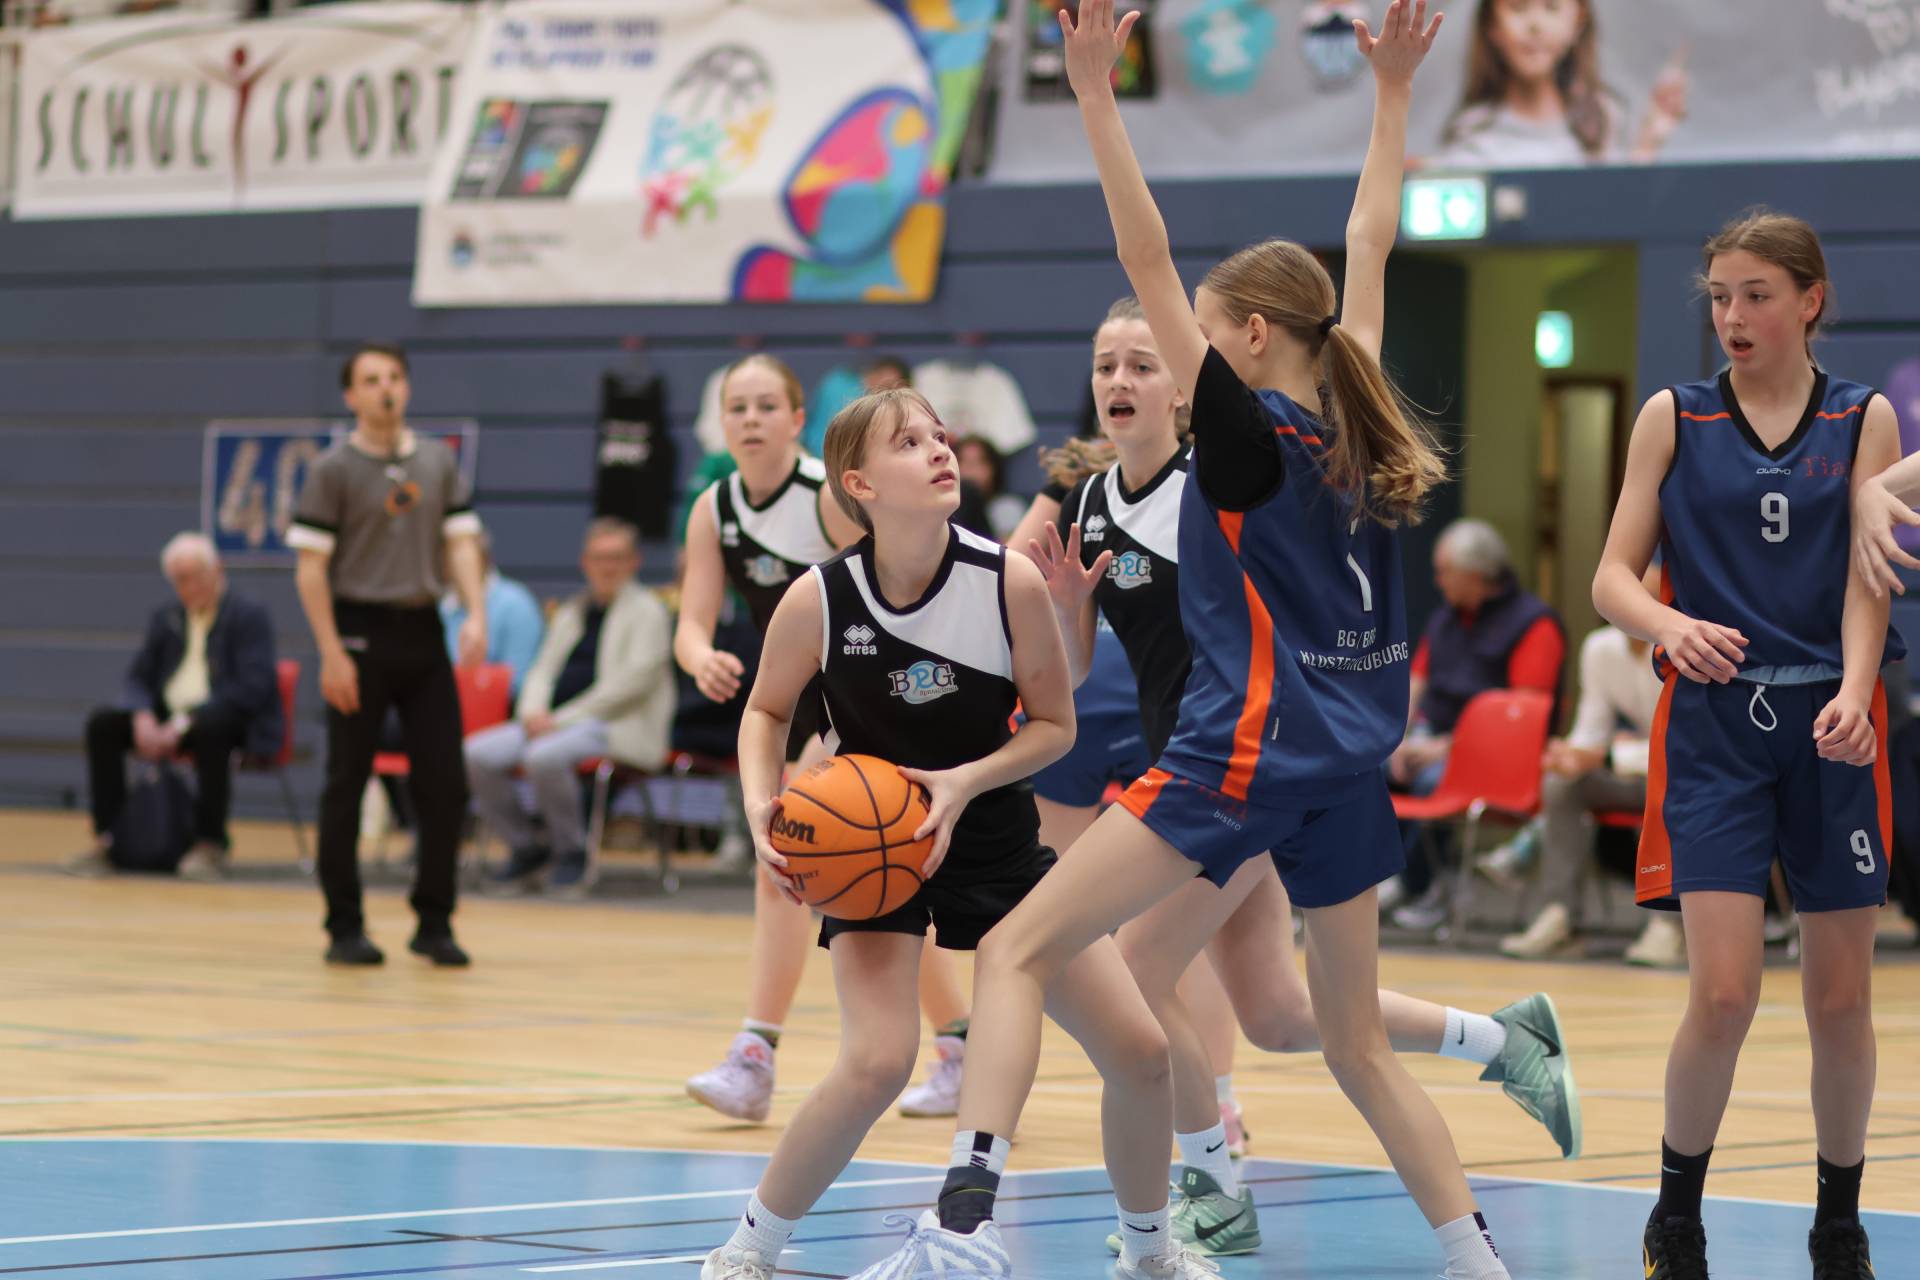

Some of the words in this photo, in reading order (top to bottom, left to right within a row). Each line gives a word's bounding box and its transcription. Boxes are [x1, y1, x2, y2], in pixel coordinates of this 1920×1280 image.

[1760, 491, 1790, 543] 9
[1213, 808, 1242, 831] bistro
[1849, 828, 1876, 875] 9
